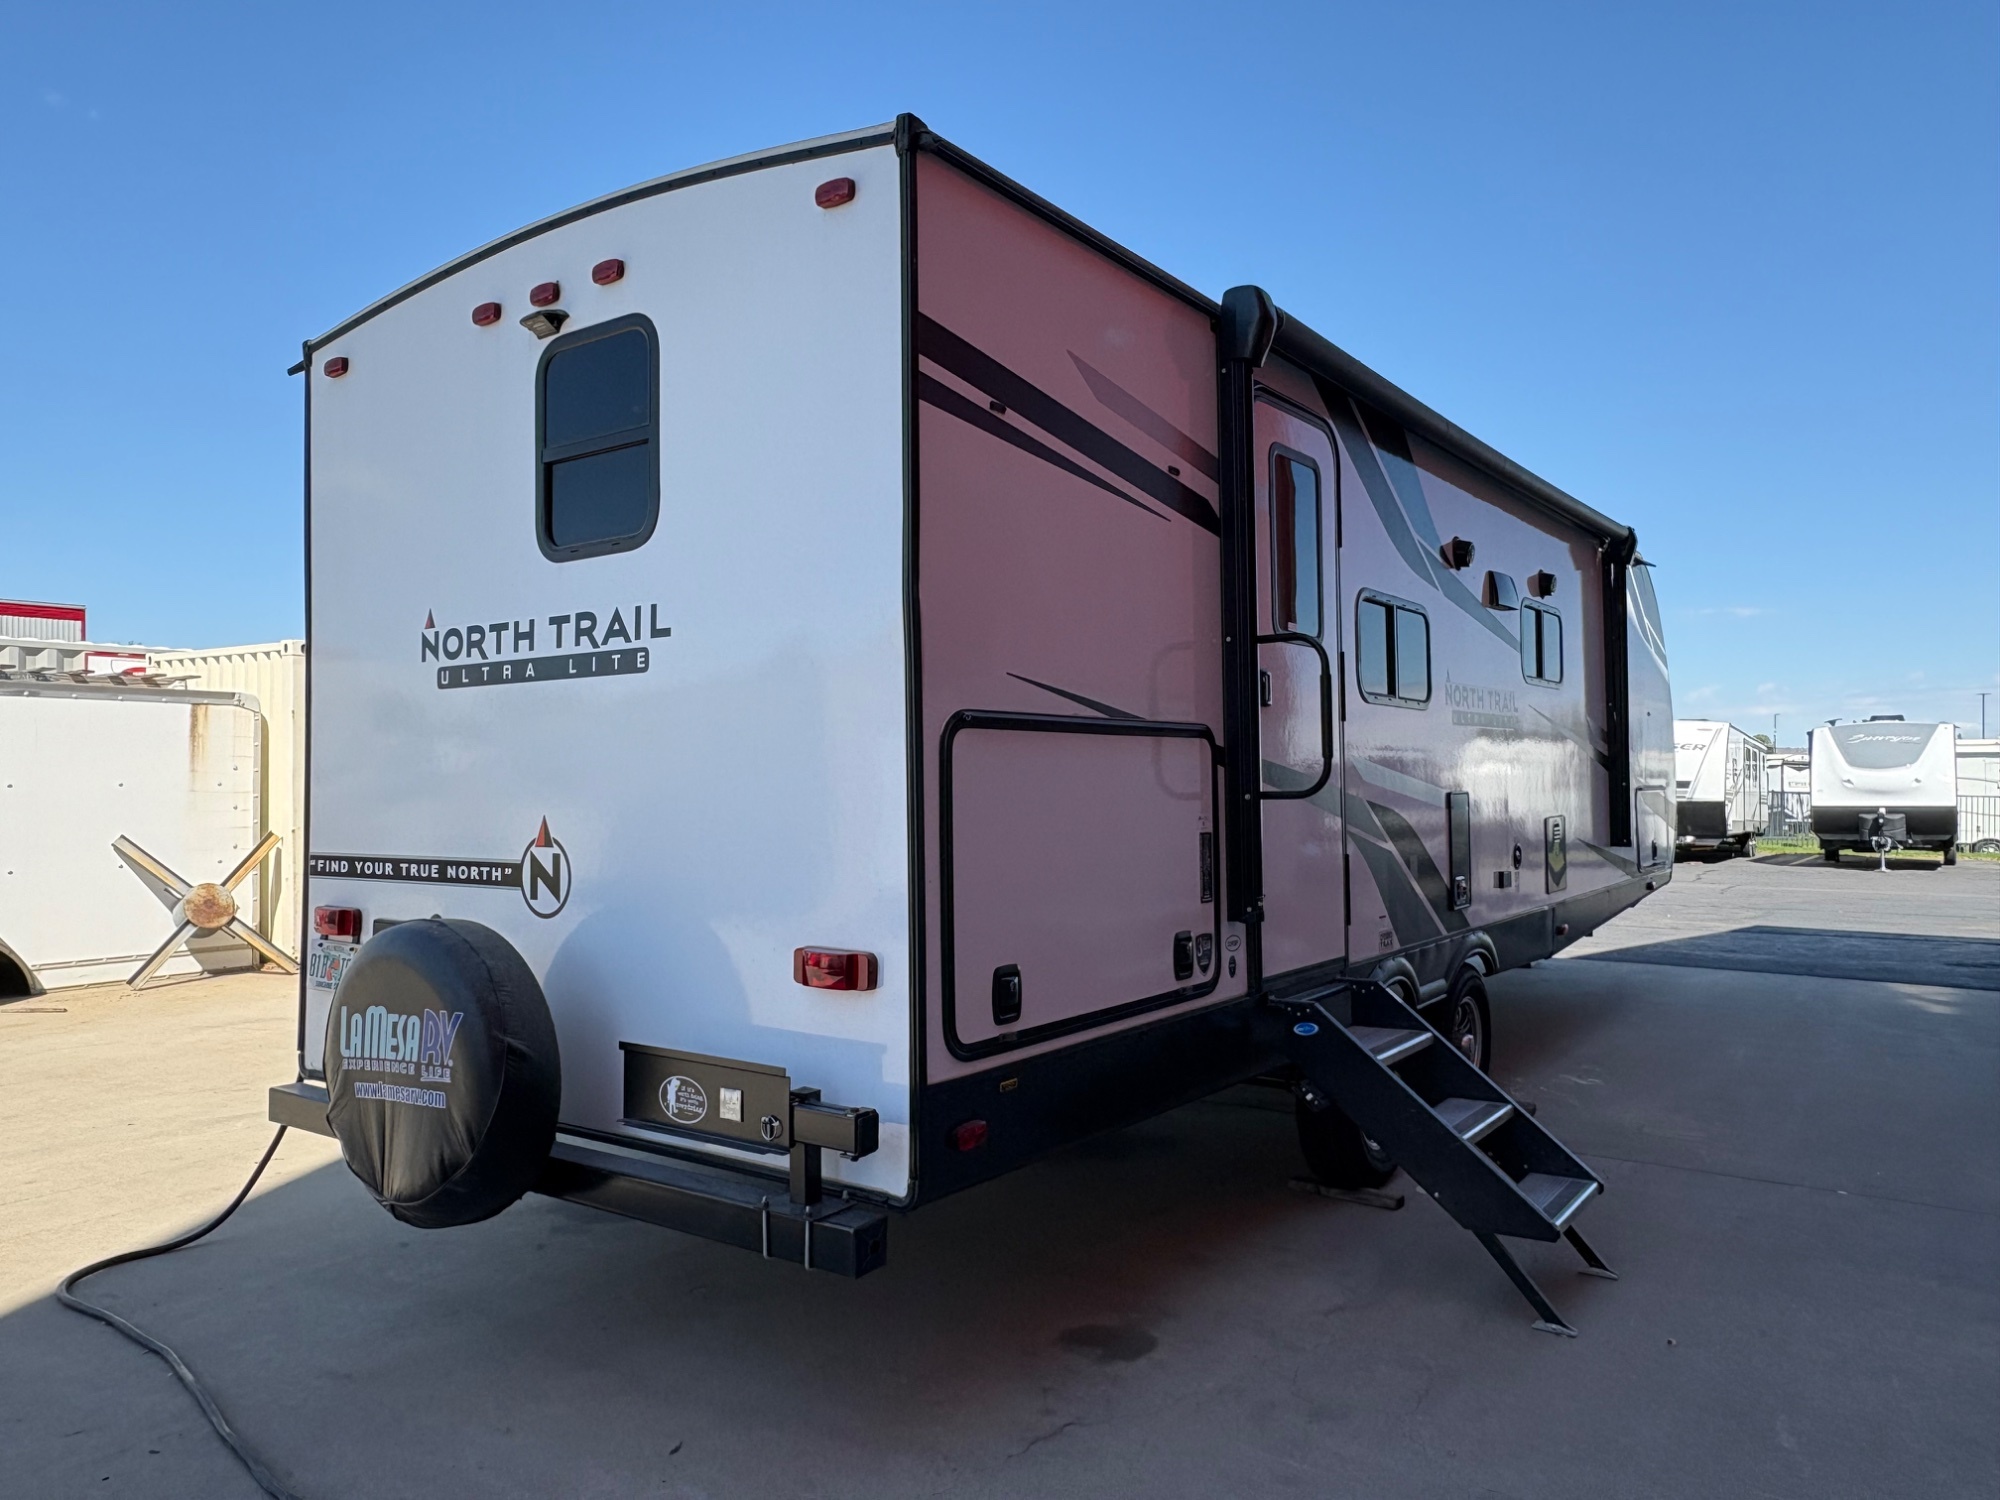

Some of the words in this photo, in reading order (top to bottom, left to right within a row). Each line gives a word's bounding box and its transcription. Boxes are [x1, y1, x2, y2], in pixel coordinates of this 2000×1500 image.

[421, 617, 535, 663] NORTH
[548, 603, 672, 649] TRAIL
[440, 662, 535, 685] ULTRA
[568, 651, 646, 675] LITE
[1444, 683, 1484, 710] NORTH
[354, 861, 395, 876] YOUR
[399, 863, 440, 878] TRUE
[342, 1058, 416, 1075] EXPERIENCE
[420, 1066, 452, 1080] LIFE
[354, 1081, 446, 1109] www.lamesarv.com
